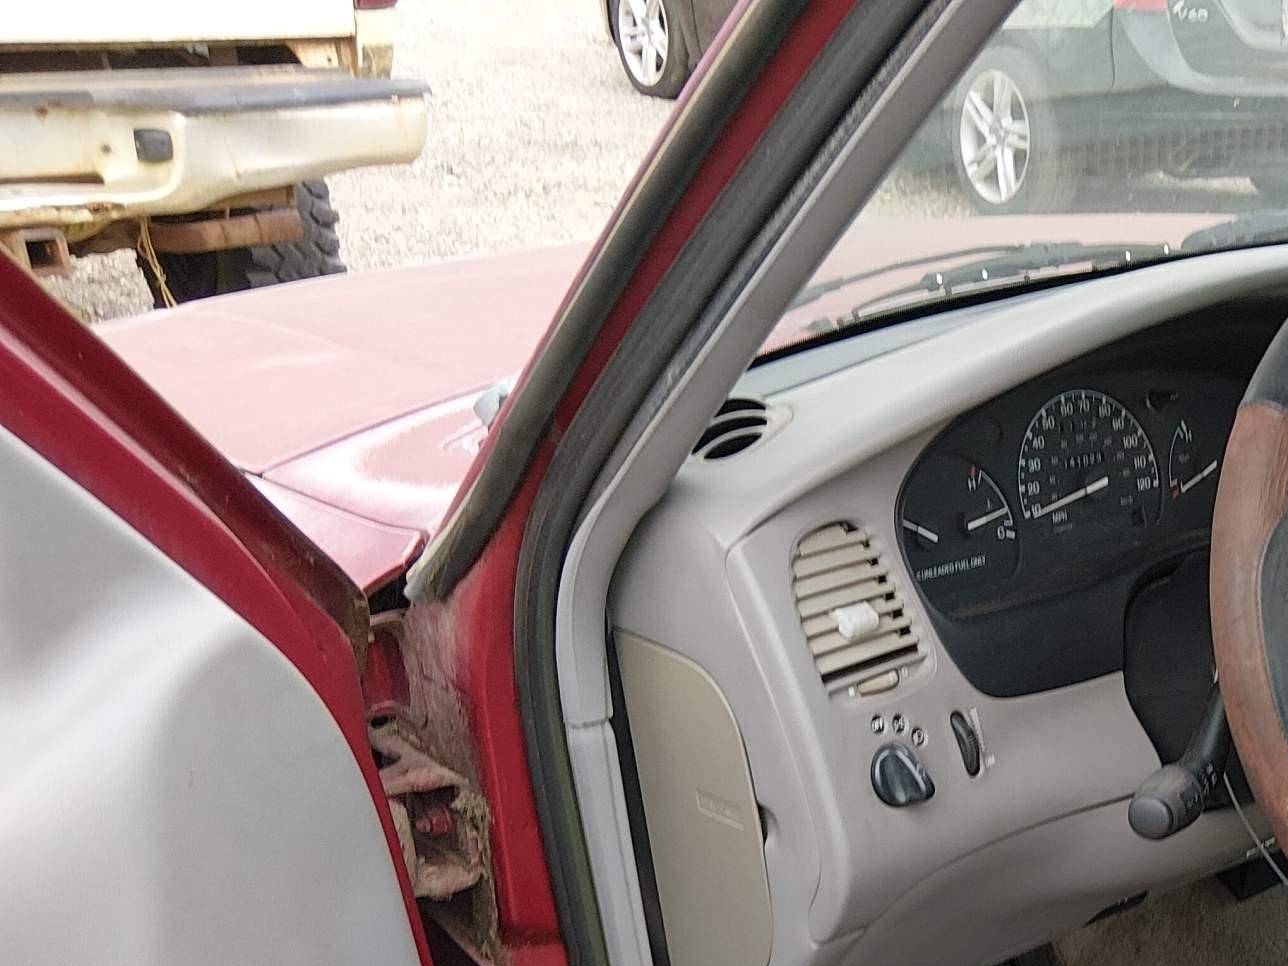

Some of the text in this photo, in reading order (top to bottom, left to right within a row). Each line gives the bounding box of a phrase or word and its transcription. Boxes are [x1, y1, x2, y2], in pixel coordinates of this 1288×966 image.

[1060, 402, 1073, 417] 60
[1077, 399, 1090, 413] 70
[1098, 404, 1111, 418] 80
[1112, 417, 1125, 431] 90
[1032, 436, 1045, 450] 40
[1122, 434, 1138, 449] 100
[1027, 457, 1041, 473] 30
[1134, 455, 1147, 471] 110
[1027, 481, 1040, 497] 20
[1137, 476, 1151, 492] 120
[1052, 510, 1068, 524] MPH
